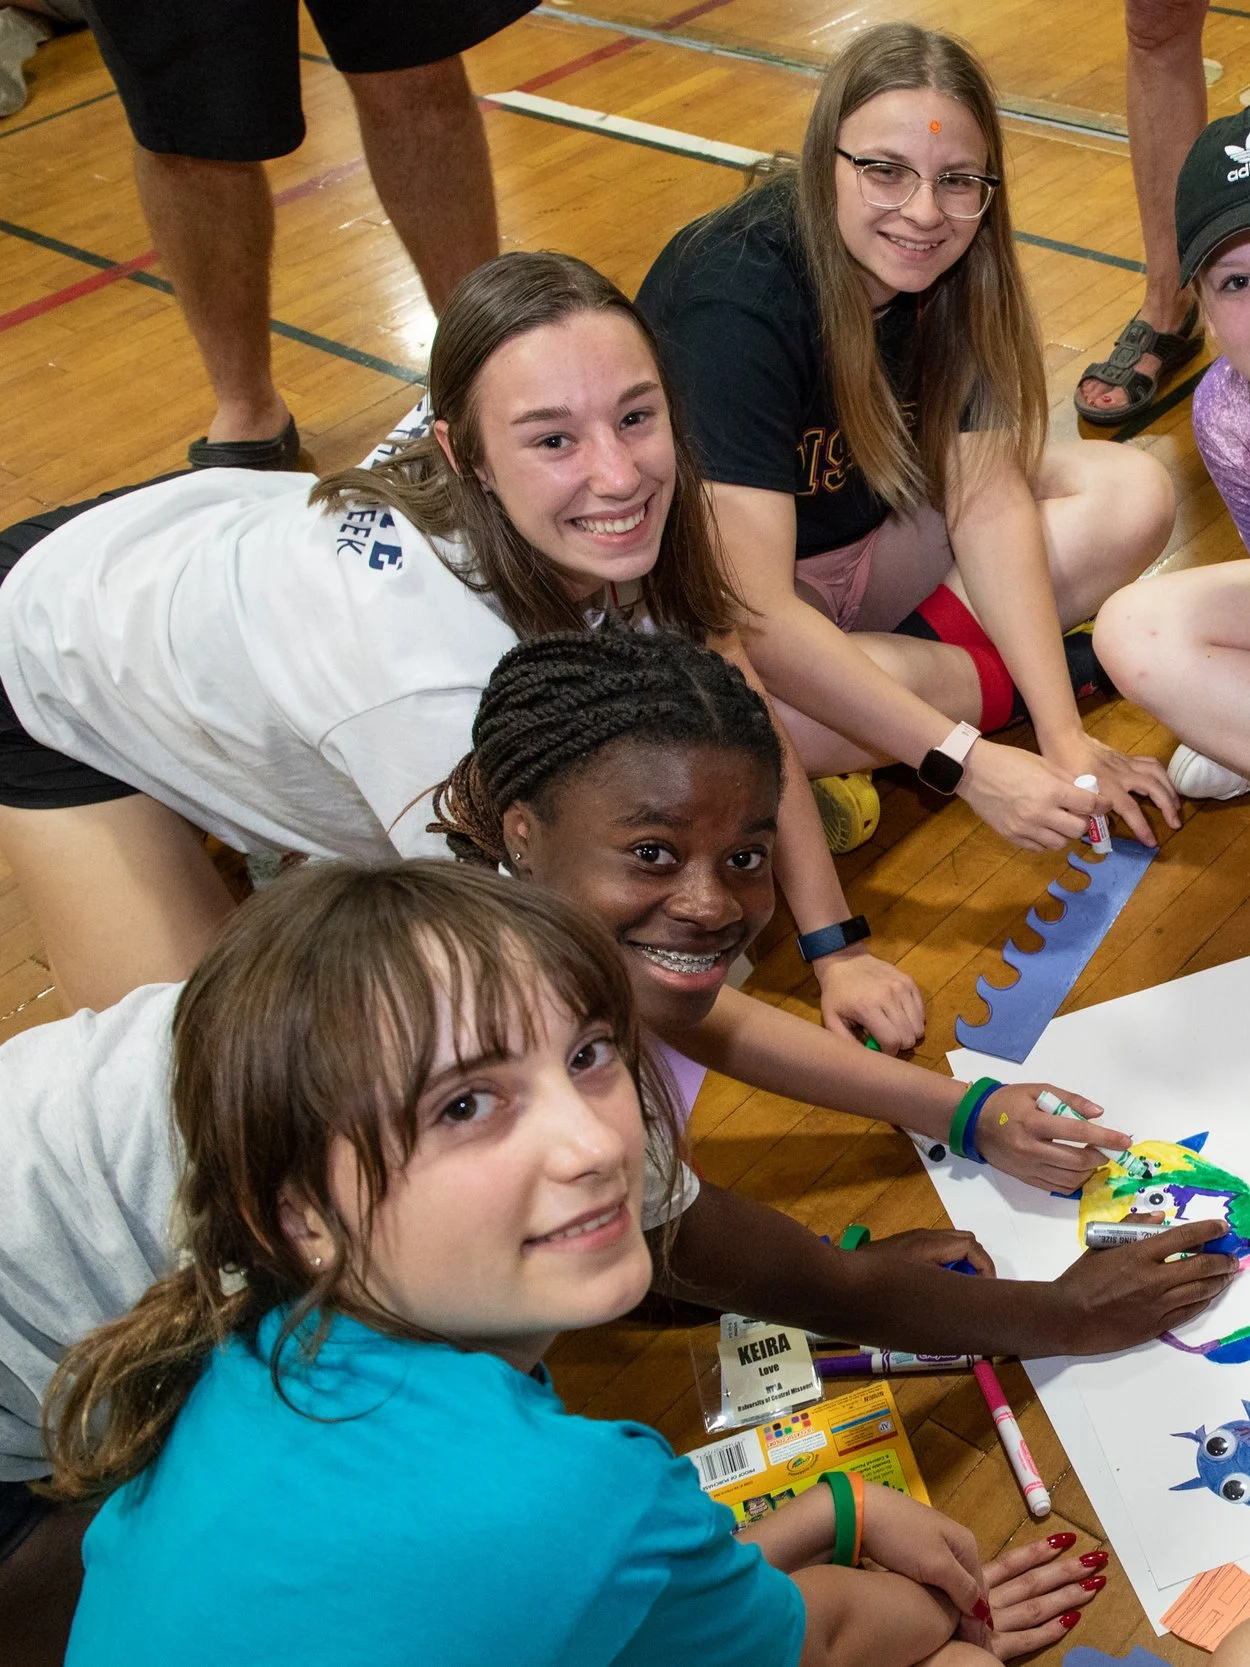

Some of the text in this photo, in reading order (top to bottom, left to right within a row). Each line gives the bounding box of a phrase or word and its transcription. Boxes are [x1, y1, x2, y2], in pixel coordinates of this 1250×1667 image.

[336, 500, 379, 557] EEK
[737, 1332, 792, 1366] KEIRA
[758, 1363, 780, 1377] Love
[738, 1400, 765, 1412] University
[771, 1389, 791, 1400] Central
[791, 1382, 814, 1395] Missouri
